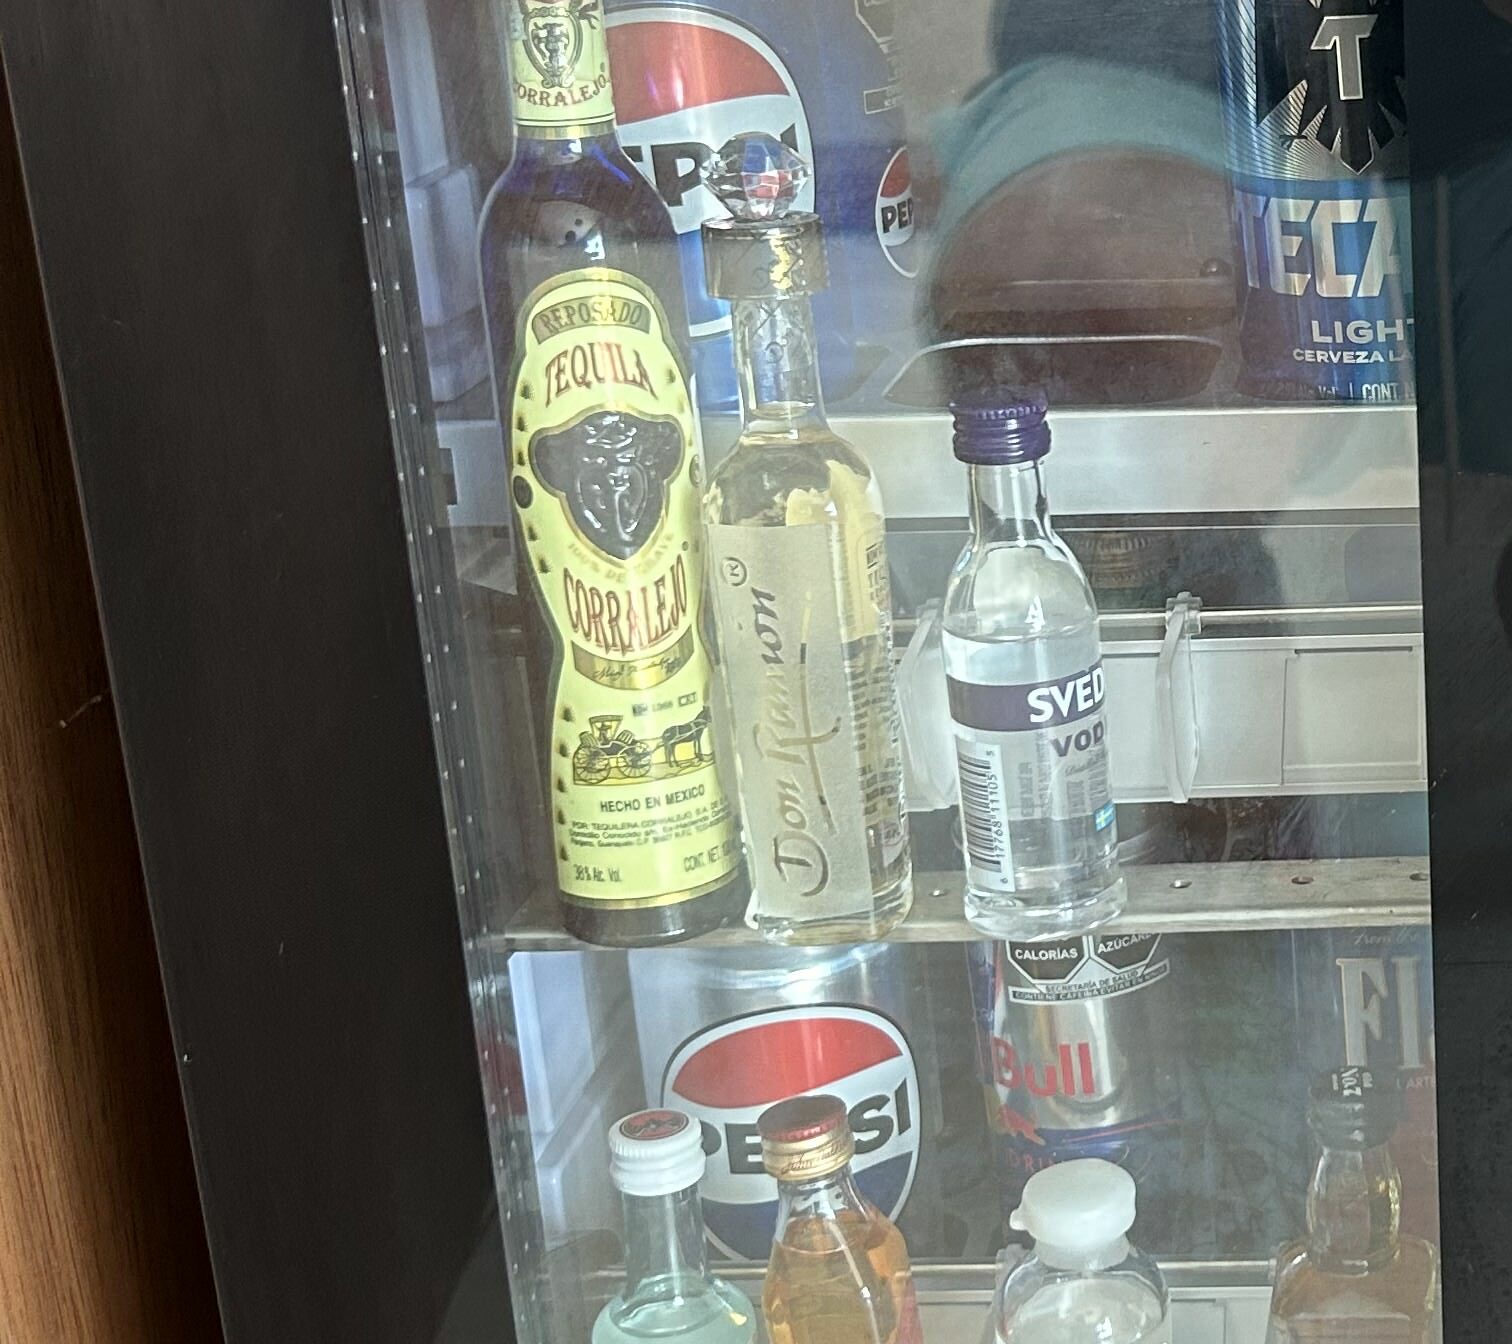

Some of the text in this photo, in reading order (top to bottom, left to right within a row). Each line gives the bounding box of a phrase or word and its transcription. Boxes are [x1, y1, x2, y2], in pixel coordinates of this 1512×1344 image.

[1310, 14, 1379, 101] T
[540, 294, 643, 334] REPOSADO
[545, 341, 658, 408] TEQUILA
[1293, 348, 1385, 364] CERVEZA
[564, 554, 688, 656] CORRALEJO
[601, 784, 706, 813] HECHO EN MEXICO
[772, 777, 829, 900] Don
[1014, 947, 1078, 961] CALORÍAS
[992, 1037, 1096, 1098] Bull
[700, 1077, 912, 1175] ESI
